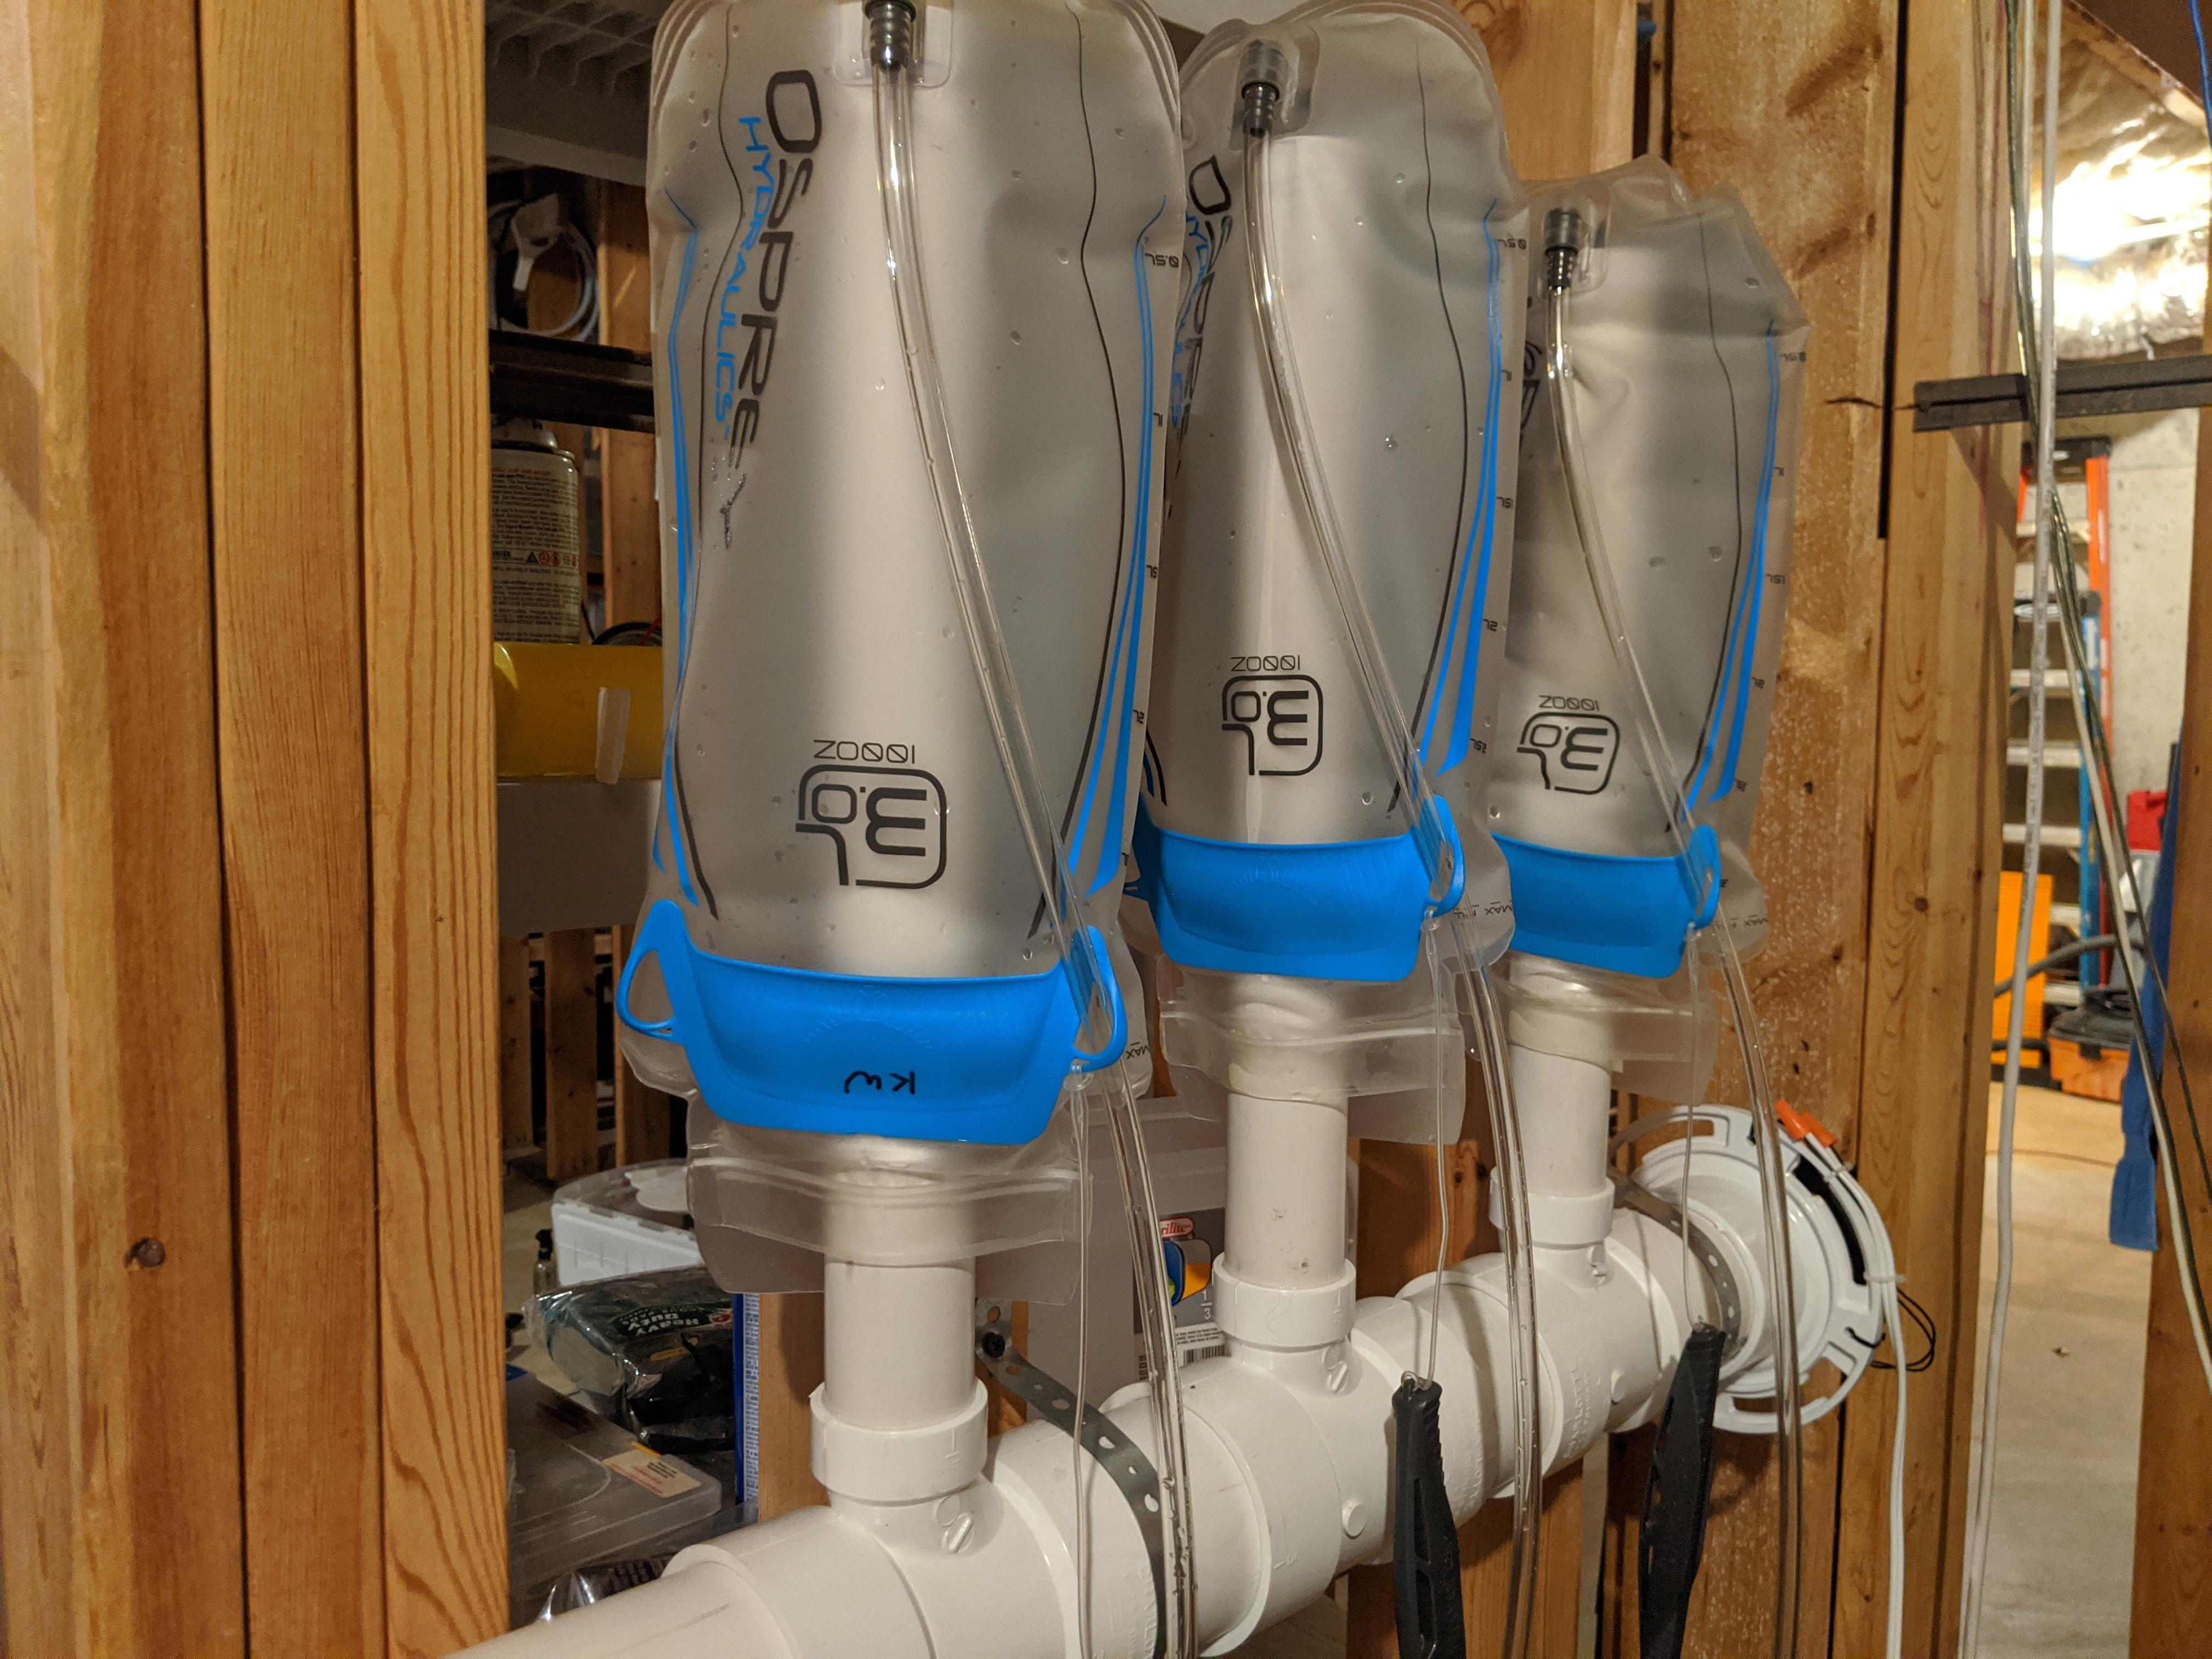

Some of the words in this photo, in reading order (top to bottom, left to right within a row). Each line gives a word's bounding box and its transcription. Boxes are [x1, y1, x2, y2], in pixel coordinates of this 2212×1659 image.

[715, 117, 774, 422] HYDRAULICS
[1483, 618, 1498, 632] 2L
[1484, 904, 1513, 916] MAX
